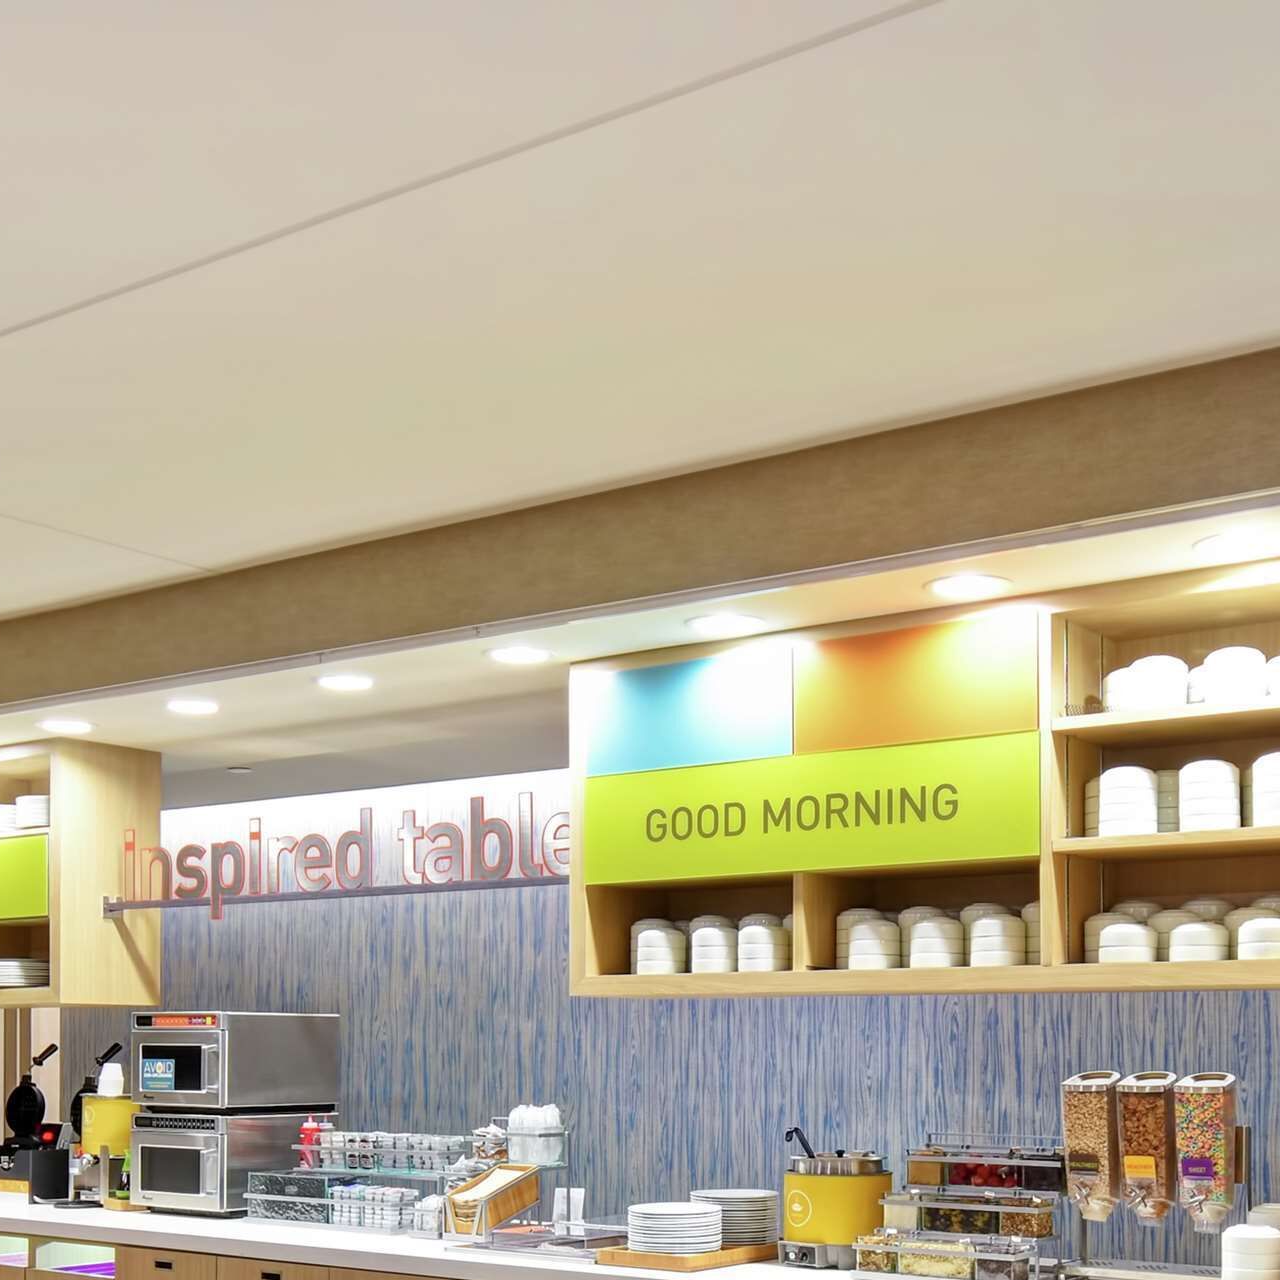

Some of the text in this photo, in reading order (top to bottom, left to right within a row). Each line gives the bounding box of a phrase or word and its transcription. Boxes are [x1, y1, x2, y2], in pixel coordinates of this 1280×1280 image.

[644, 782, 960, 844] GOOD MORNING
[122, 791, 570, 921] inspired table
[143, 1060, 174, 1074] AVOID
